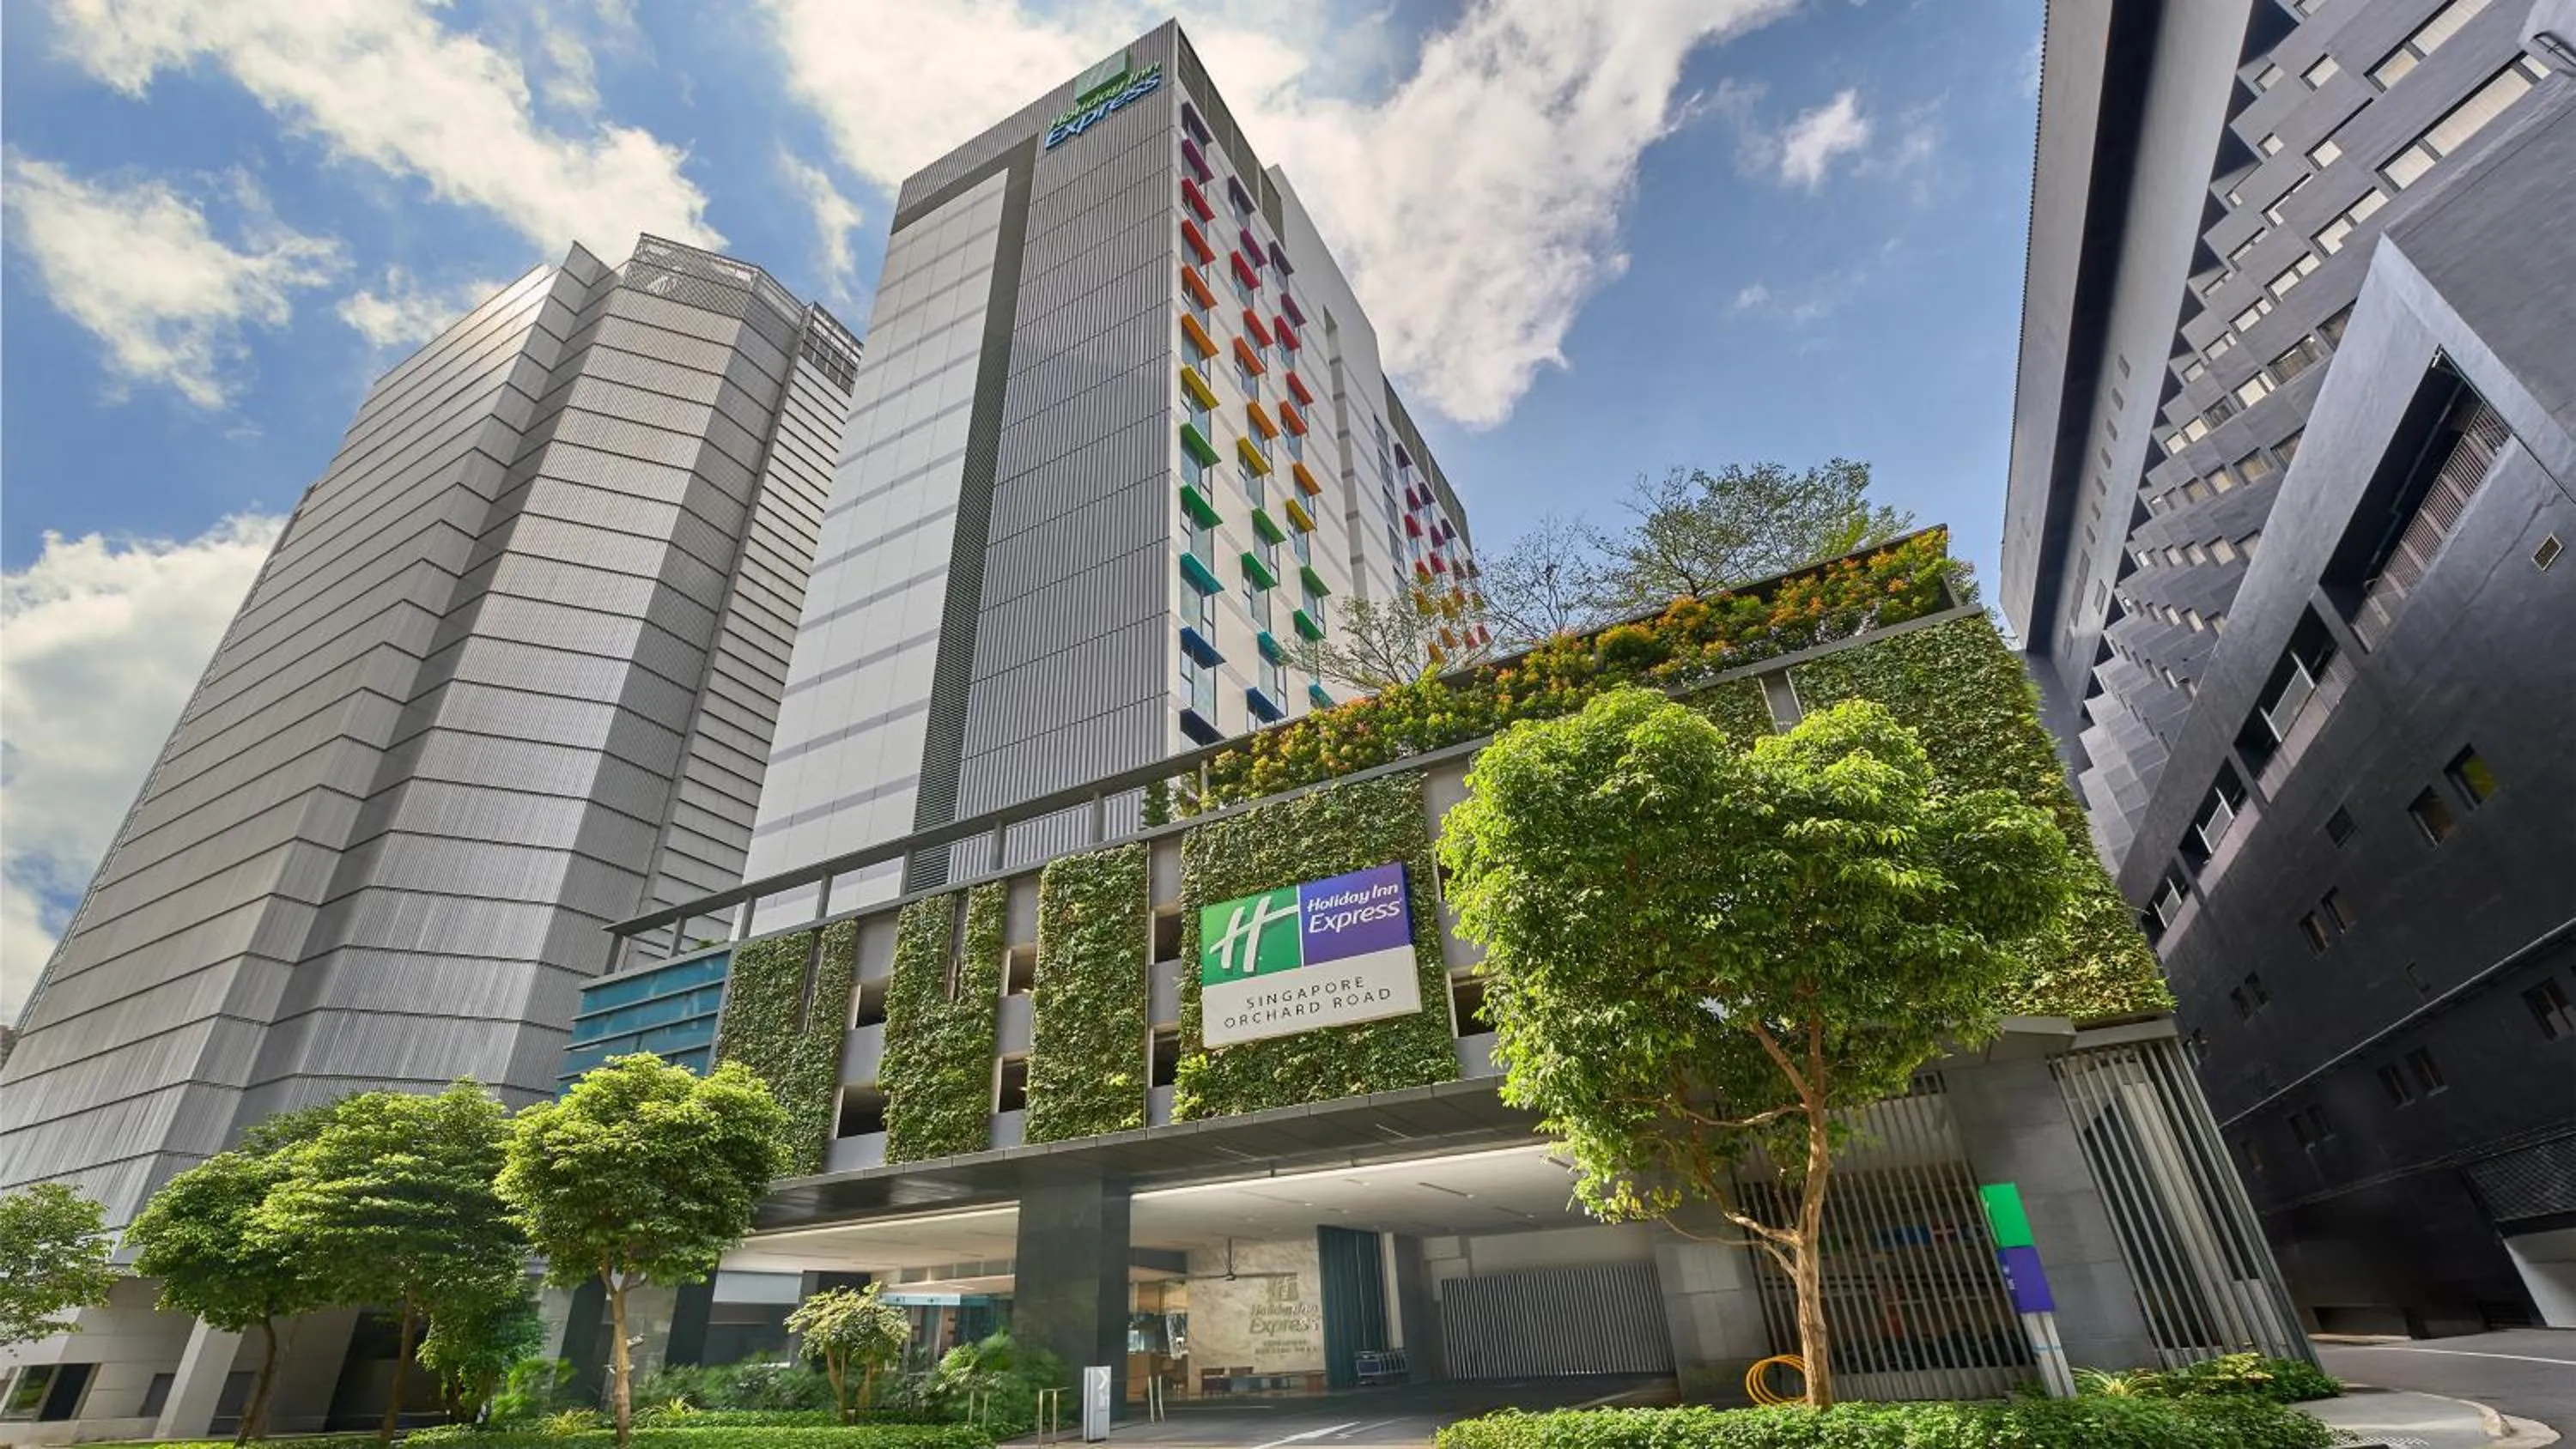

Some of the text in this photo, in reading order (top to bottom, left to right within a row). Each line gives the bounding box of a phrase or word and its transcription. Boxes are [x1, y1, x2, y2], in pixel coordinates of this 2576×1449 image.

[1045, 74, 1163, 150] Express
[1307, 883, 1399, 913] Holiday Inn
[1309, 900, 1401, 933] Express
[1224, 988, 1391, 1029] ORCHARD ROAD
[1246, 976, 1365, 1009] SINGAPORE
